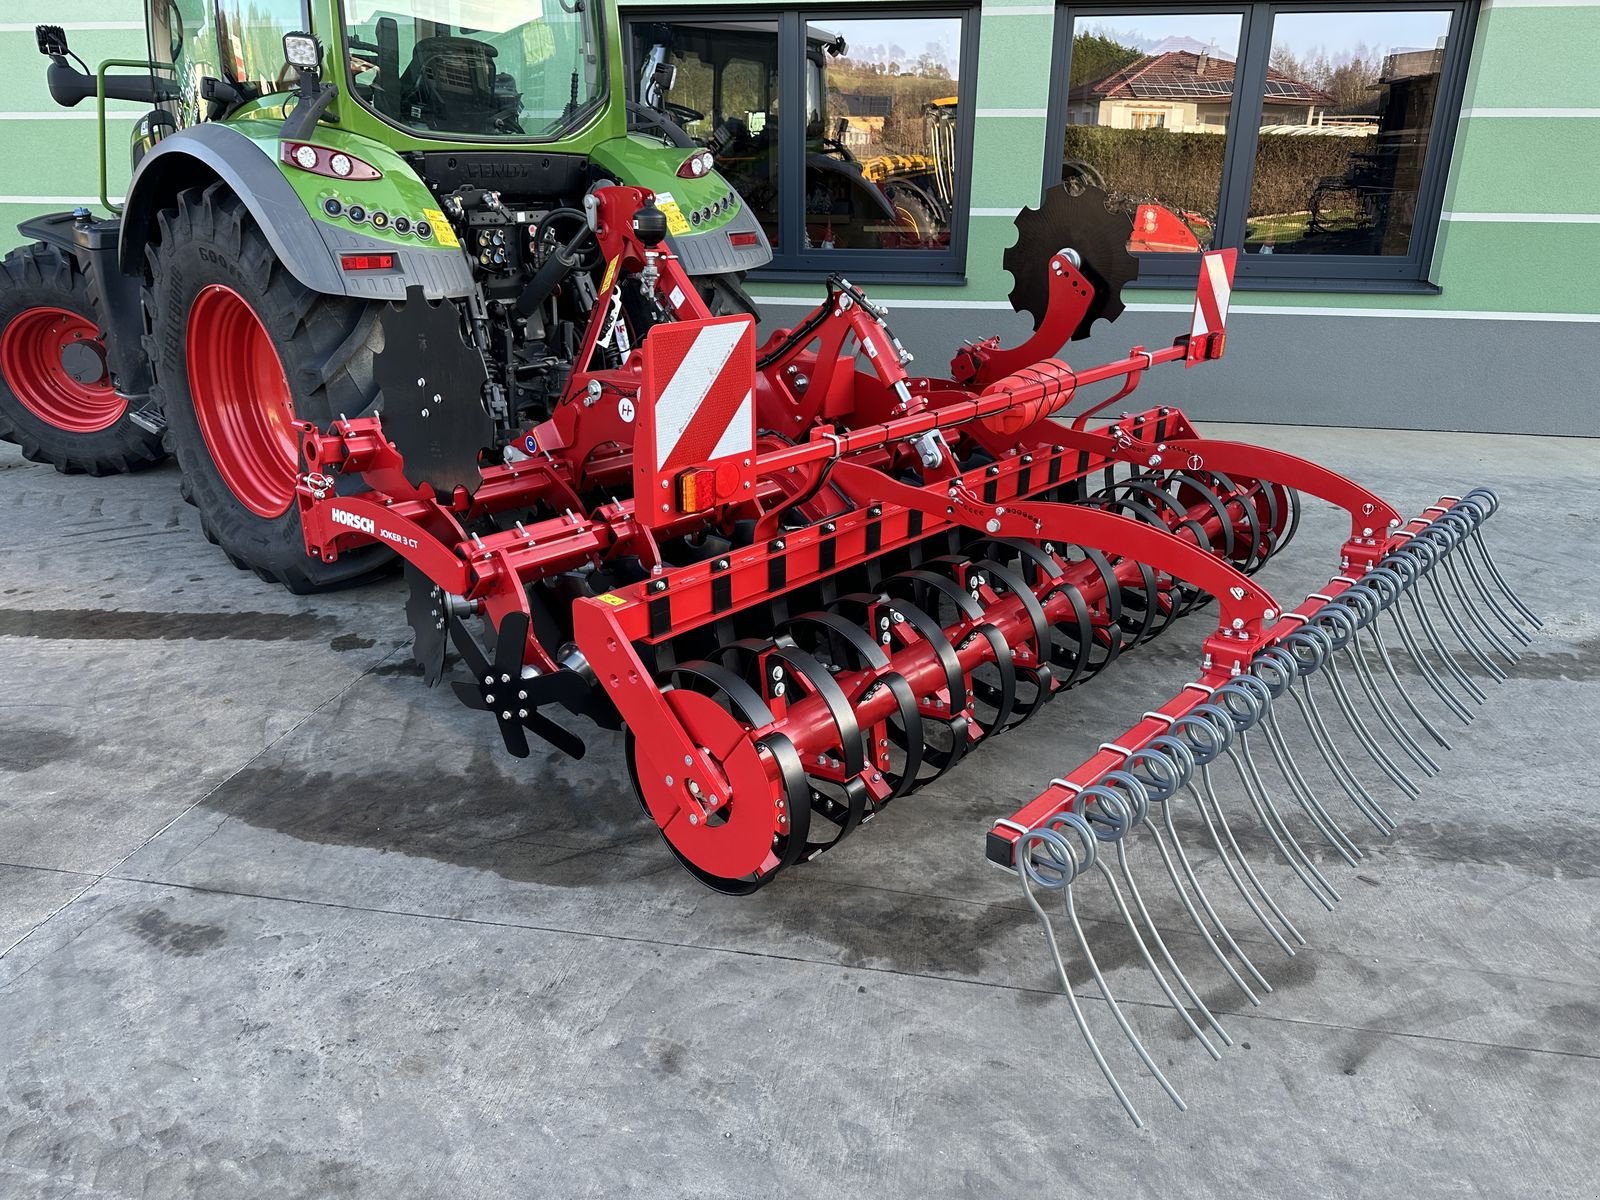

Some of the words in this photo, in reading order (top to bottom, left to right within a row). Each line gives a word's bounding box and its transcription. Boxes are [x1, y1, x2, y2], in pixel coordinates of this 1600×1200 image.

[467, 163, 532, 178] FENDT
[331, 507, 374, 534] HORSCH
[380, 528, 402, 543] JOKER
[402, 536, 407, 545] 3
[408, 538, 418, 549] CT
